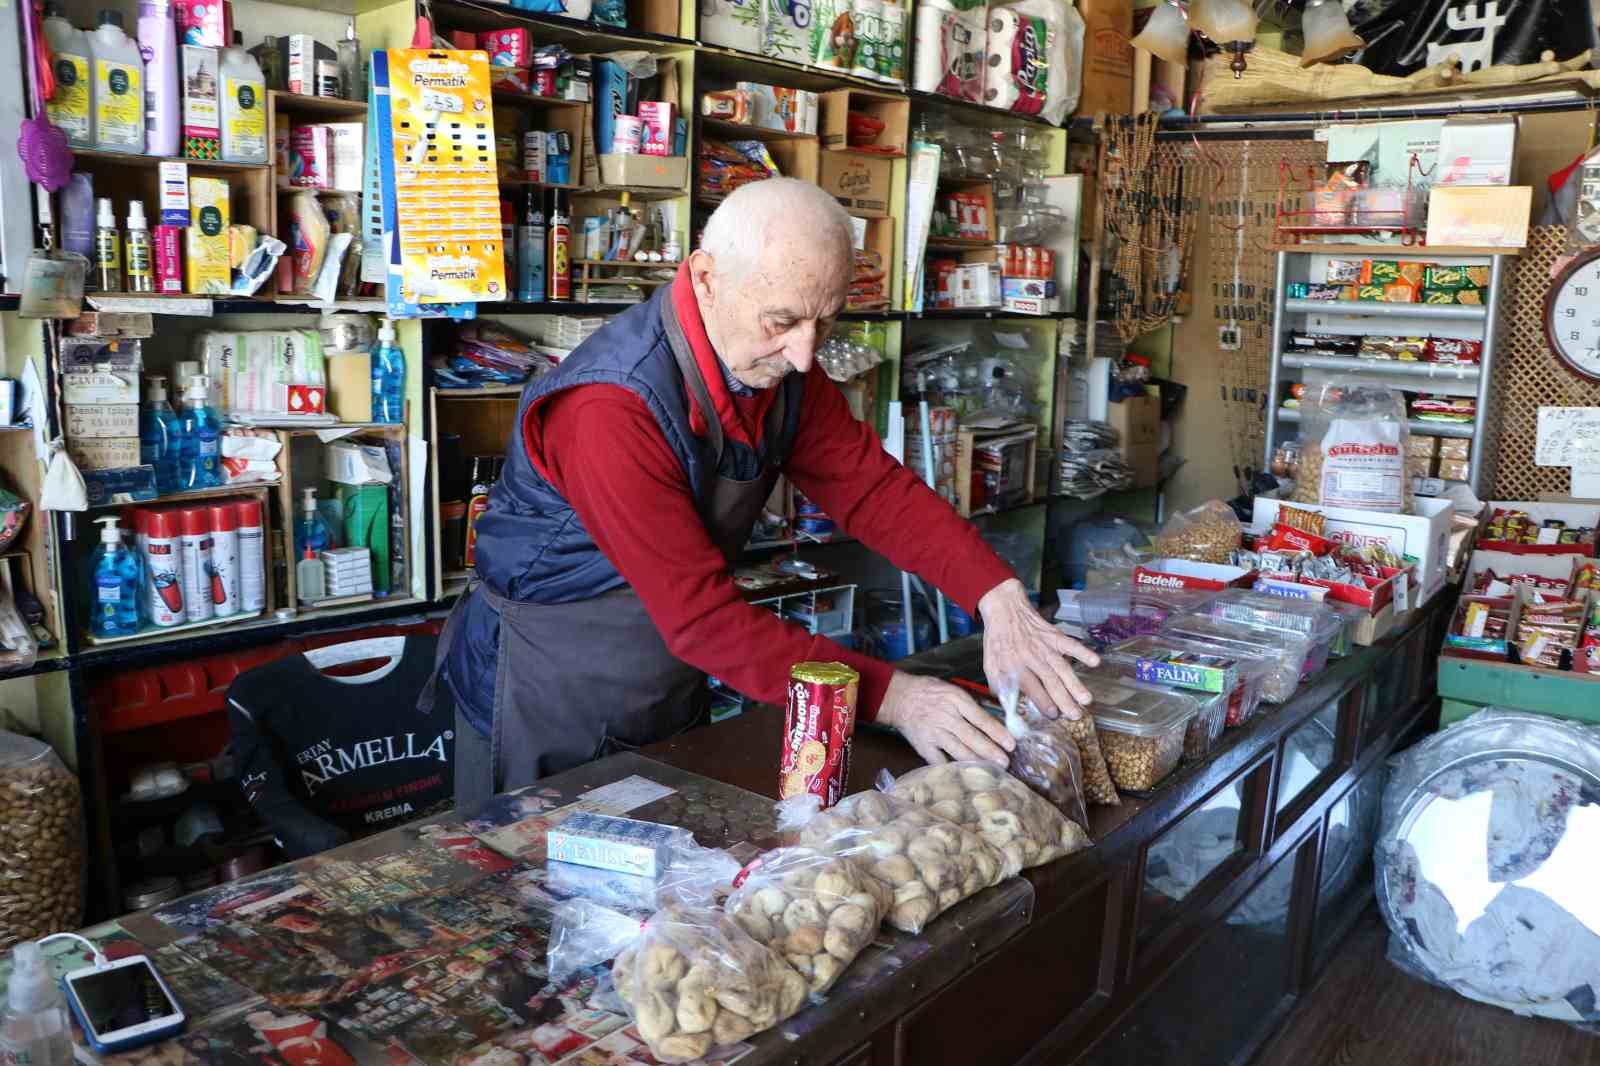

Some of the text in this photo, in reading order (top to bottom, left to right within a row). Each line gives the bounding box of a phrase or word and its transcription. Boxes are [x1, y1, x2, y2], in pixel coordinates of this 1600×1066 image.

[1018, 25, 1037, 97] Papia
[414, 74, 466, 87] Permatik
[431, 269, 477, 280] Permatik
[1575, 286, 1588, 297] 10
[1566, 308, 1577, 318] 9
[1137, 572, 1185, 588] tadelle
[1156, 666, 1201, 685] FALIM
[296, 737, 333, 765] ERTAY
[300, 732, 449, 798] ARMELLA
[364, 802, 414, 825] KREMA
